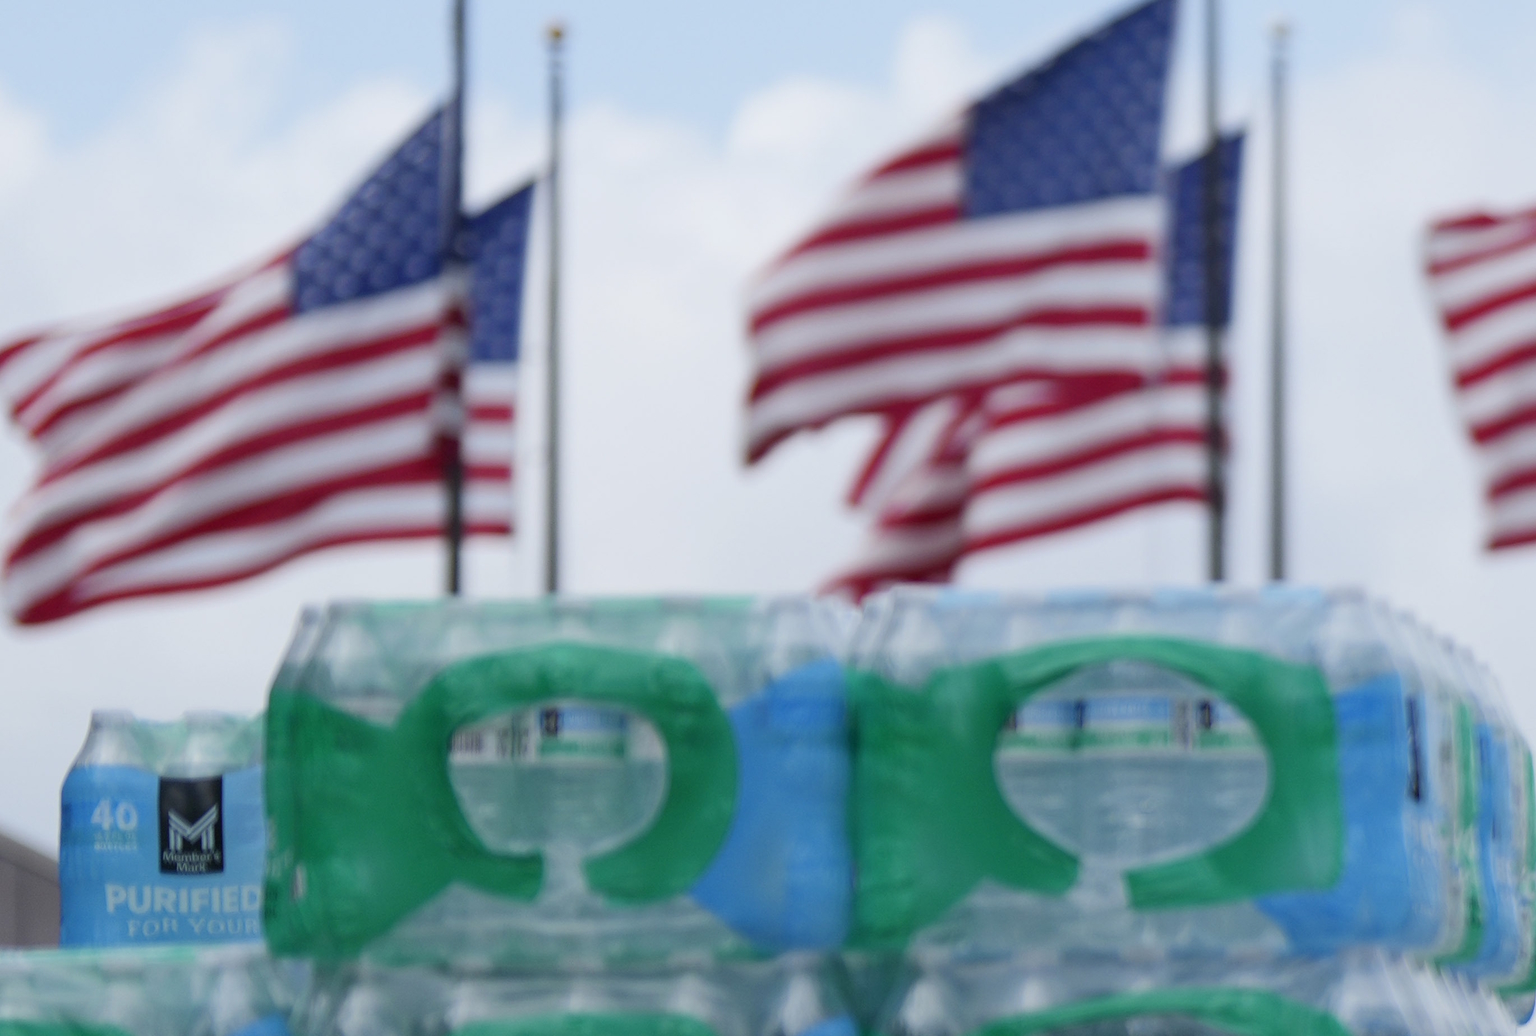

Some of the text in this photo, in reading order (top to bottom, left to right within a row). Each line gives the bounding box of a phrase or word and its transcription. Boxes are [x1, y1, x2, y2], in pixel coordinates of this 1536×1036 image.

[90, 799, 138, 831] 40
[105, 884, 260, 914] PURIFIED
[128, 918, 178, 937] FOR
